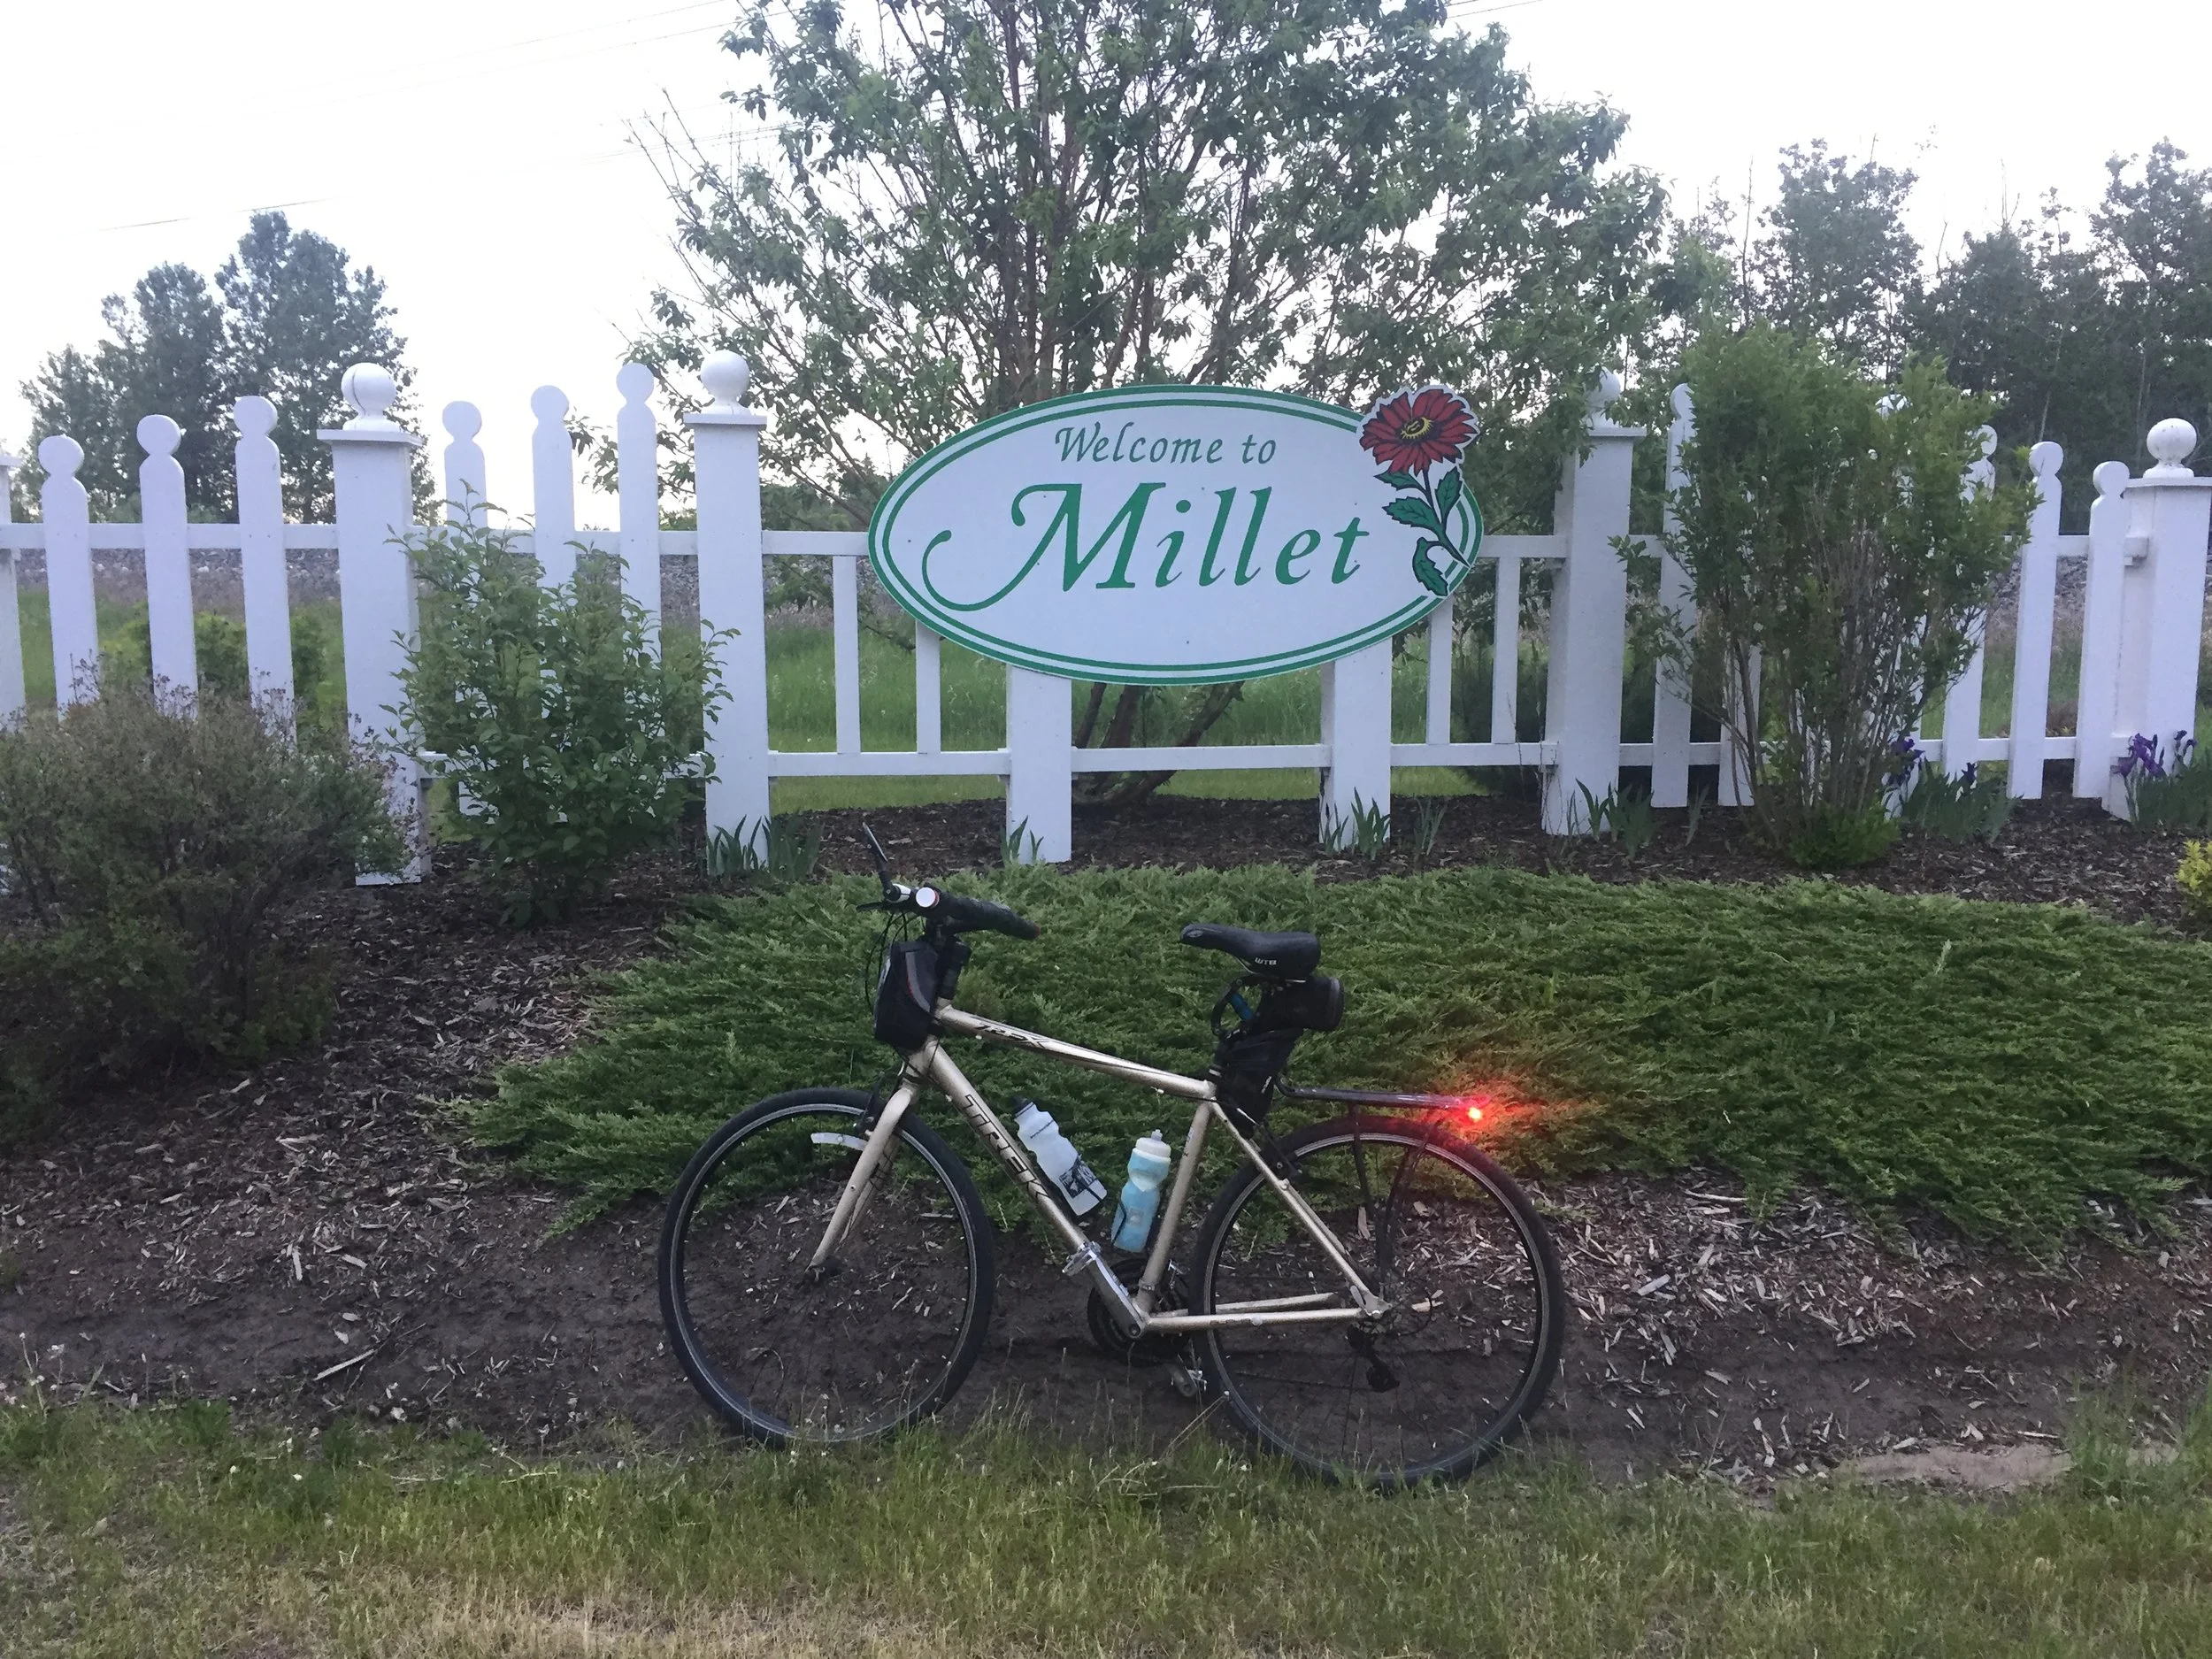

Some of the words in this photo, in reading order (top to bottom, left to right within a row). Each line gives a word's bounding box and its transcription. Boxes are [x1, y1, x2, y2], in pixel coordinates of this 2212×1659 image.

[1056, 421, 1224, 464] Welcome
[1242, 434, 1276, 464] to
[922, 482, 1370, 611] Millet
[963, 1094, 1052, 1205] TREK
